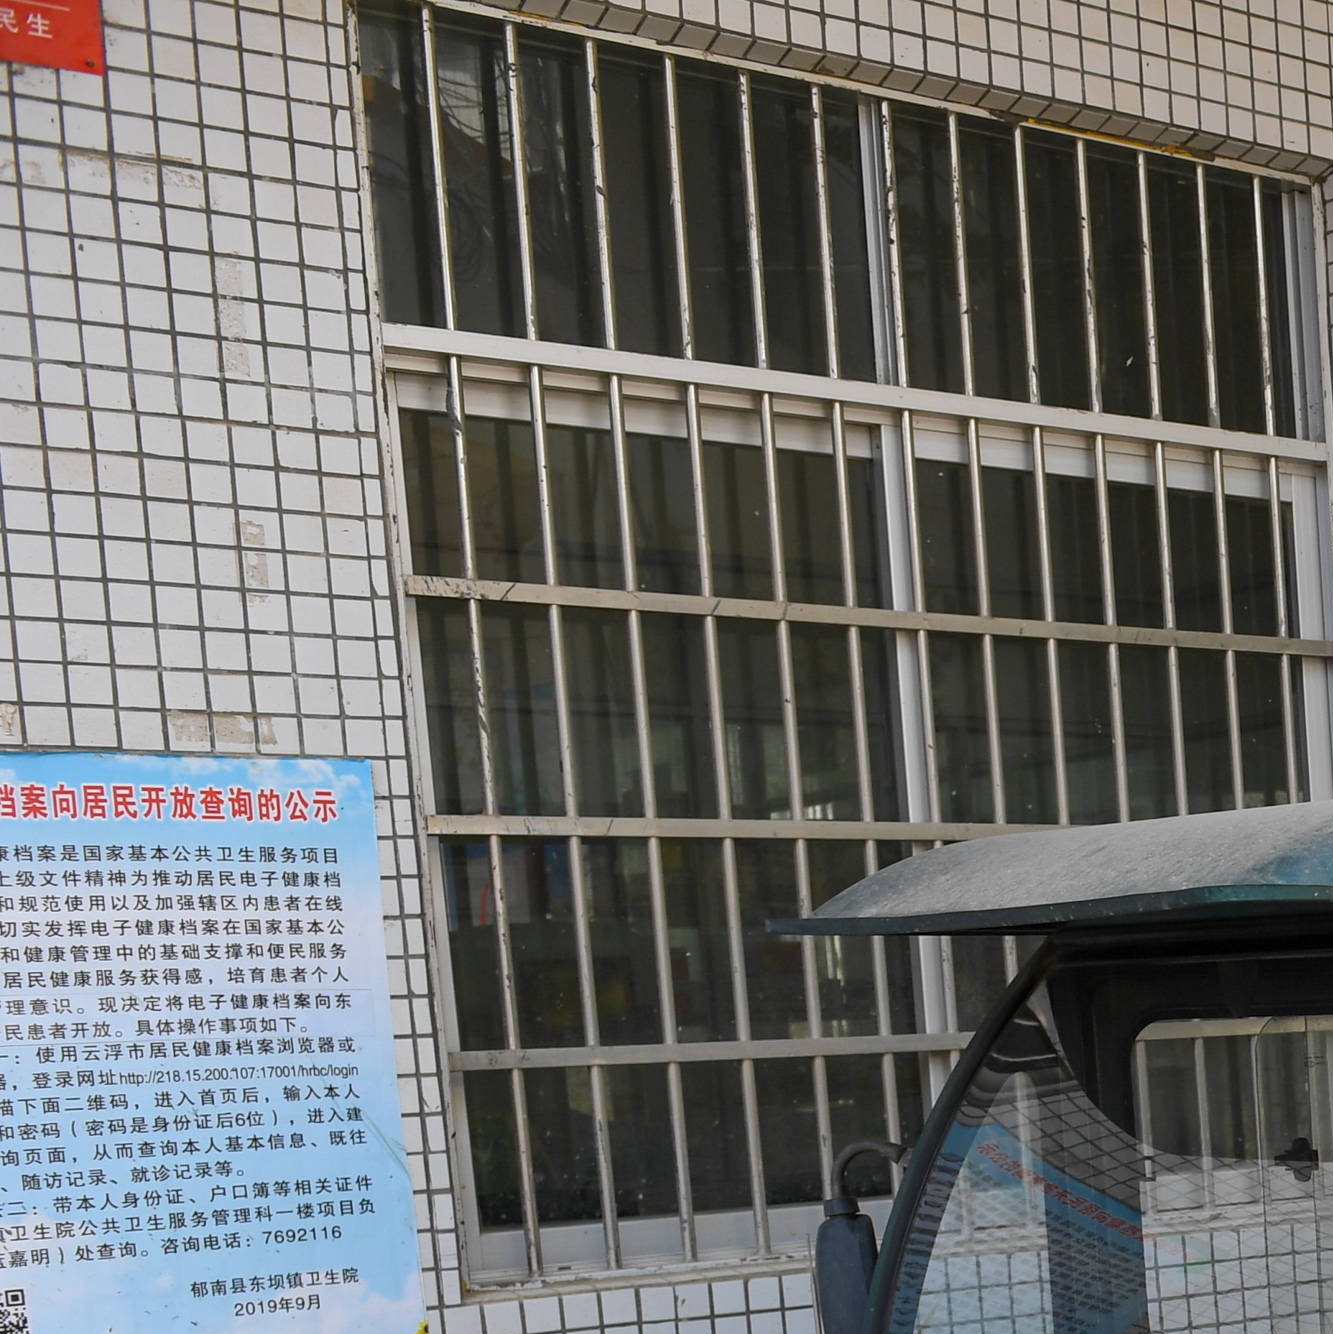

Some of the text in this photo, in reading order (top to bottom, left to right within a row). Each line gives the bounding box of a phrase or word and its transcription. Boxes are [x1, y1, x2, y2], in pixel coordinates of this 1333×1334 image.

[0, 8, 53, 39] 民生
[0, 993, 352, 1016] 理意识。现决定将电子健康档案向东
[0, 1017, 309, 1041] 民患者开放。具体操作事项如下。
[0, 1175, 374, 1217] 二：带本人身份证、户口簿等相关证件
[189, 1267, 360, 1298] 郁南县东坝镇卫生院
[234, 1294, 322, 1318] 2019年9月
